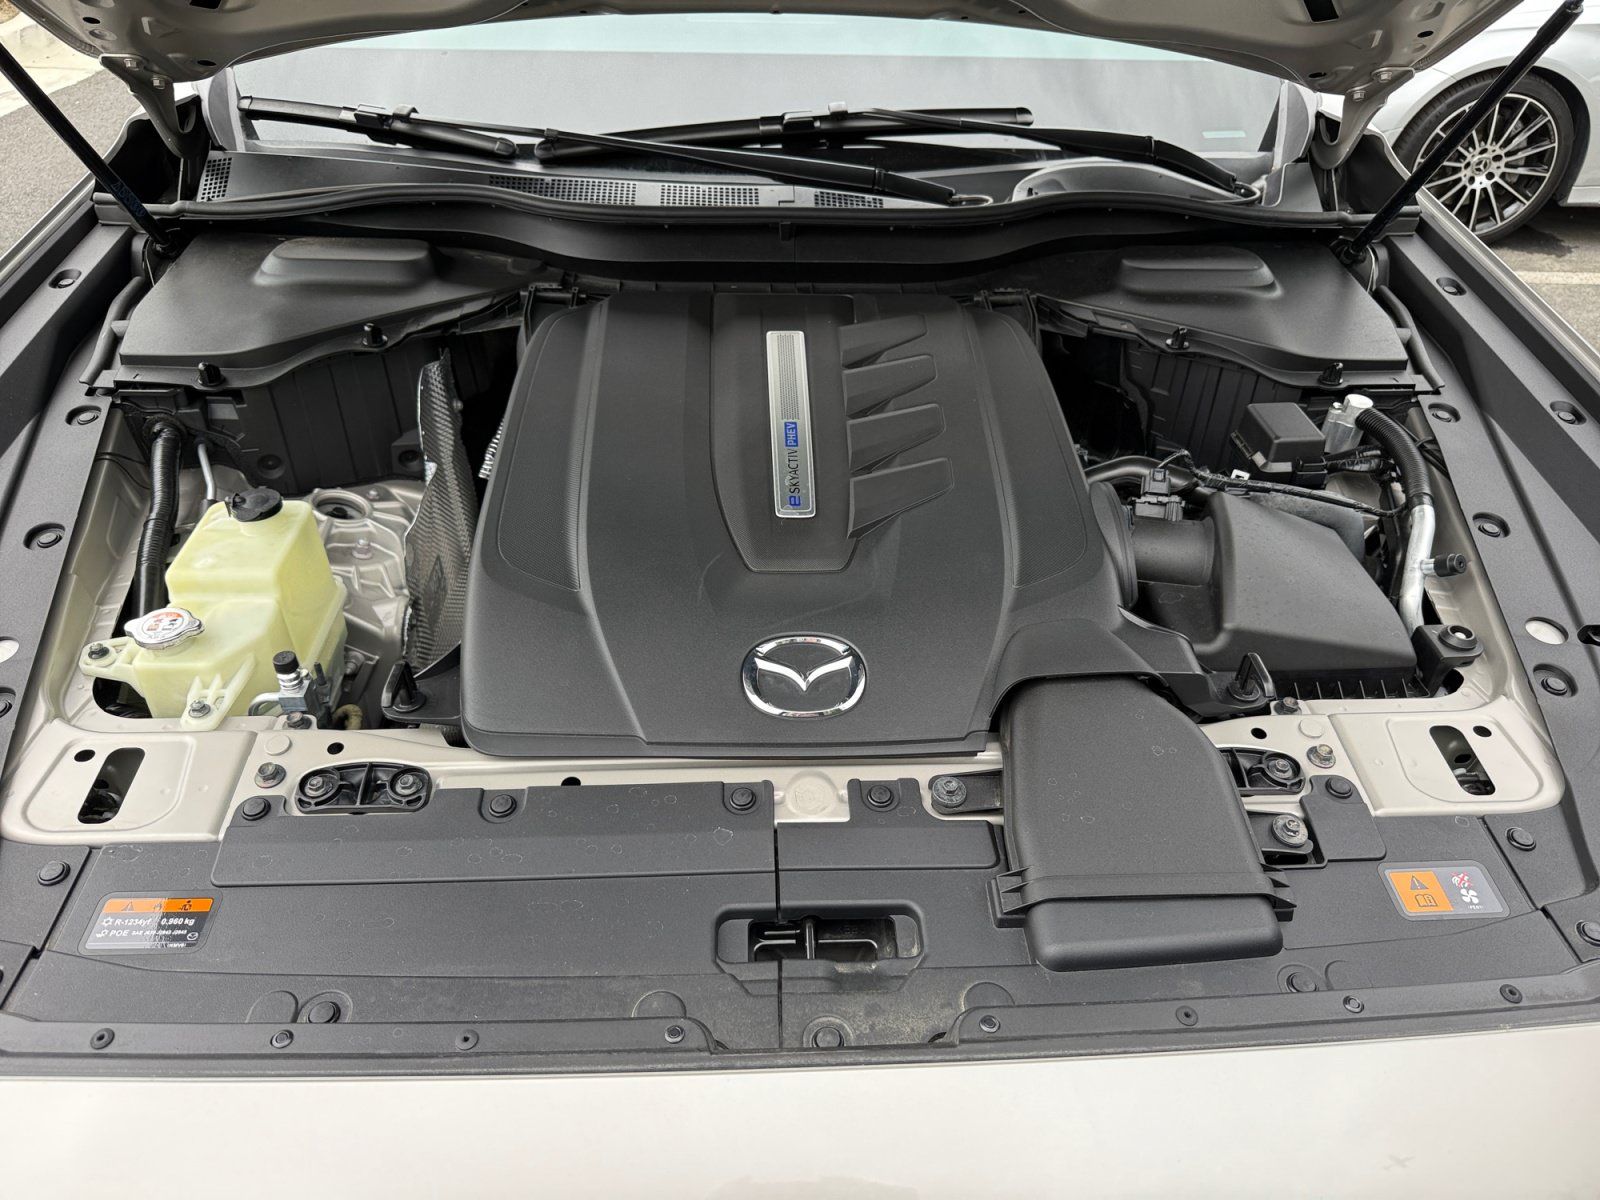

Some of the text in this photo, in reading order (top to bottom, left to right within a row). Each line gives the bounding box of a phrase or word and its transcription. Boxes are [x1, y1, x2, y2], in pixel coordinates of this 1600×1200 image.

[786, 423, 797, 446] PHEV
[788, 448, 800, 494] SKYACTIV
[114, 918, 152, 927] R-1234yf
[184, 918, 195, 926] kg
[109, 929, 130, 937] POE
